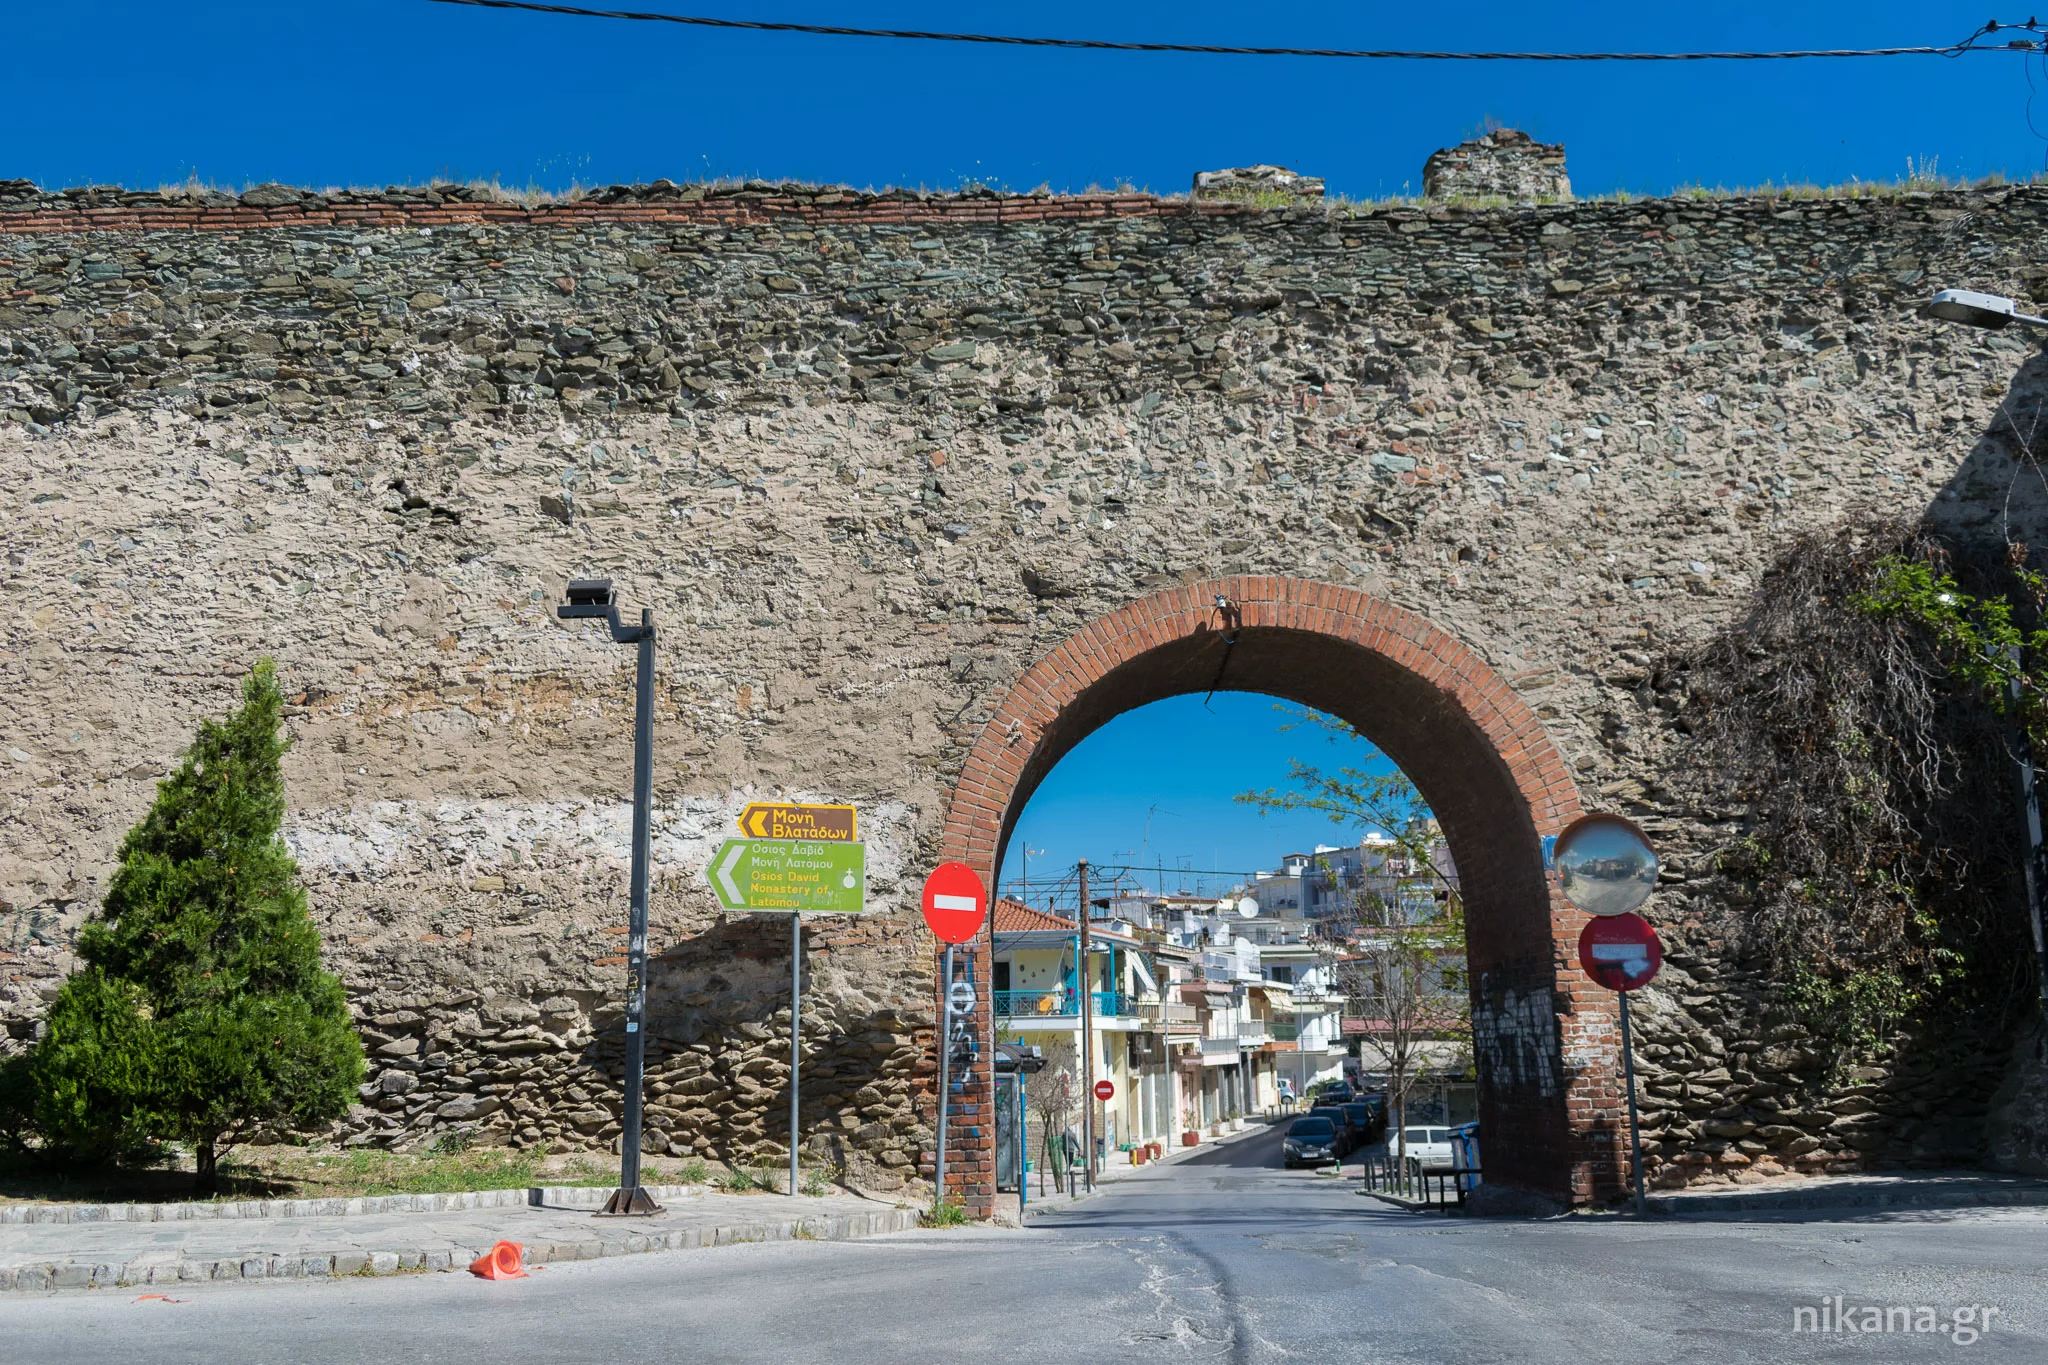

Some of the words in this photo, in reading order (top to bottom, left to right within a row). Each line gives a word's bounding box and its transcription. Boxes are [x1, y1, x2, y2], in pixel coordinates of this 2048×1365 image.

[772, 809, 815, 827] Μονή
[772, 823, 848, 839] Βλατάδων
[791, 844, 824, 857] Δαβίδ
[751, 857, 780, 870] Μονή
[785, 857, 833, 870] Λατόμου
[751, 870, 783, 881] Osios
[788, 871, 820, 882] David
[750, 883, 810, 896] Monastery
[816, 884, 829, 895] of
[750, 896, 800, 907] Latomou
